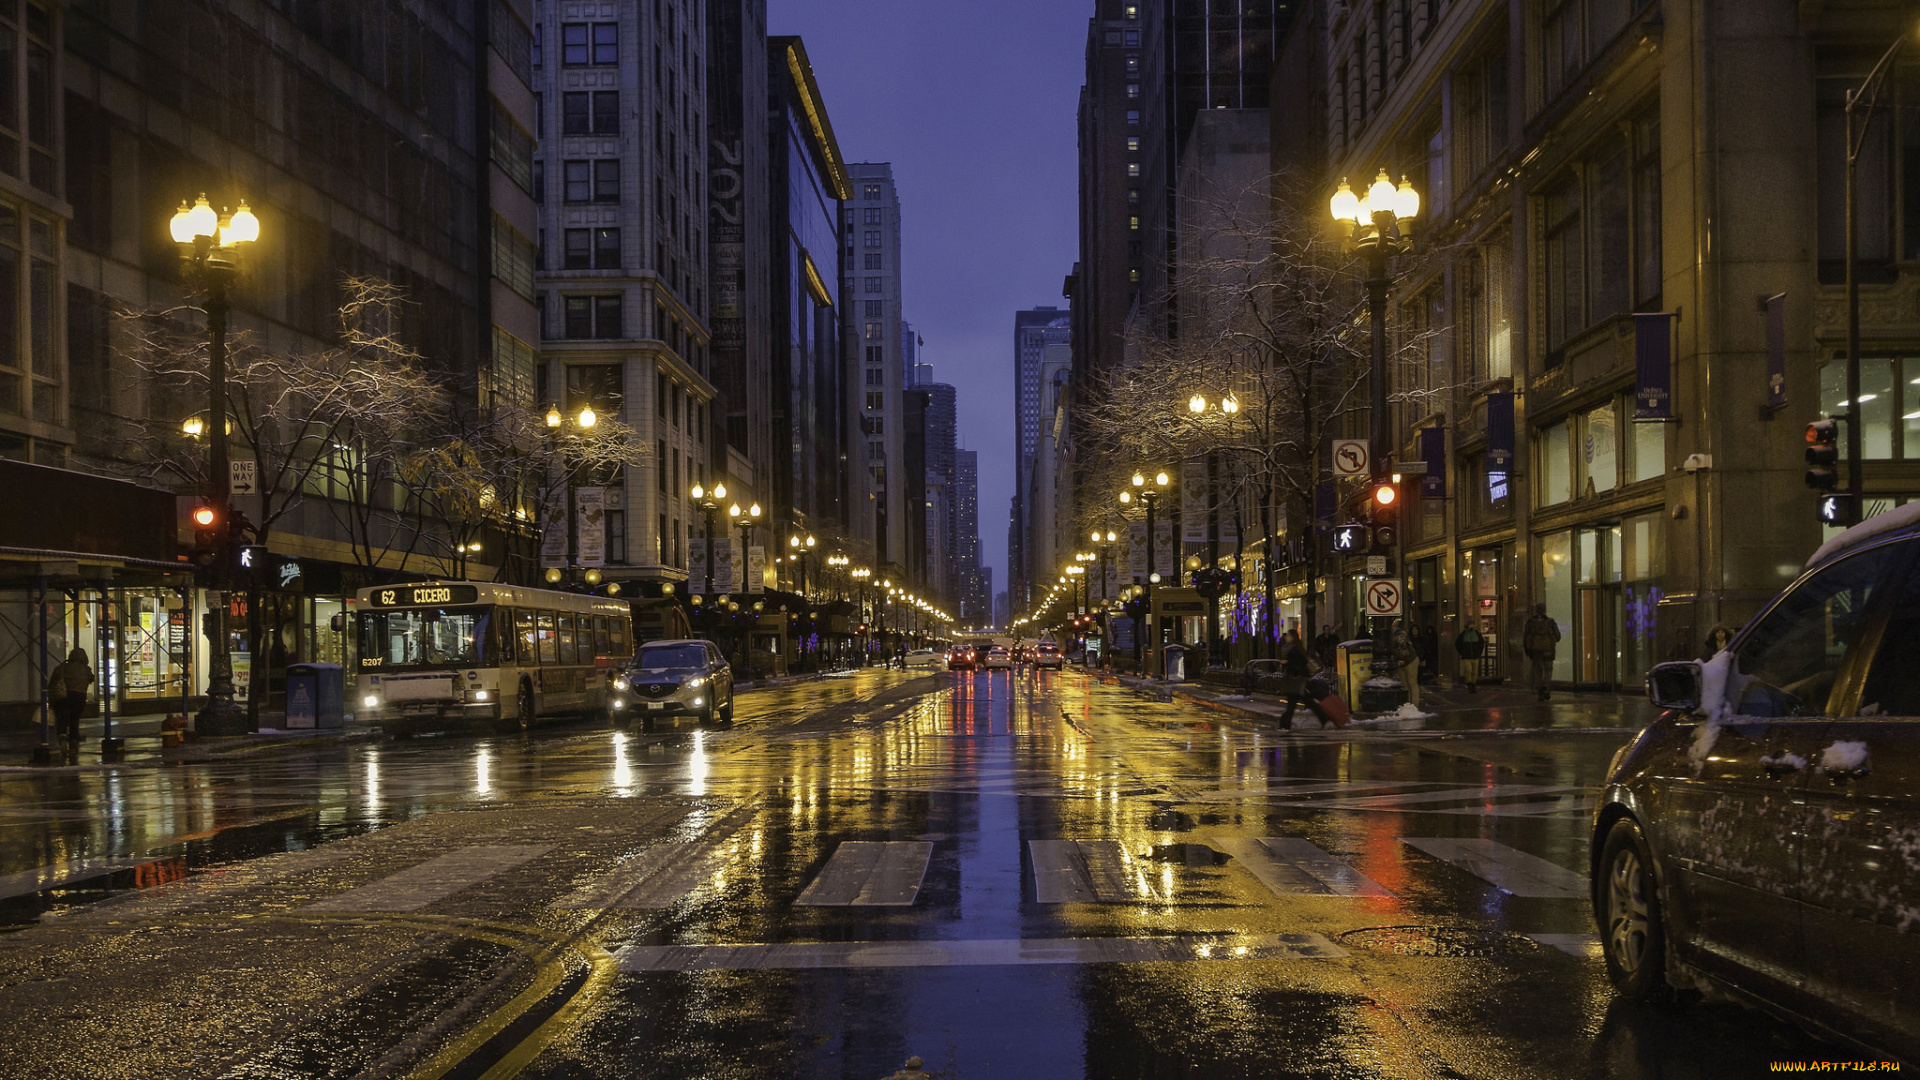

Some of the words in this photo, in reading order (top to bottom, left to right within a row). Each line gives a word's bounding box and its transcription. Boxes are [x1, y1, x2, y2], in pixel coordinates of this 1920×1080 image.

[709, 139, 742, 225] 202
[232, 462, 253, 472] ONE
[232, 472, 253, 481] WAY
[381, 590, 396, 605] 62
[413, 587, 451, 604] CICERO
[361, 657, 383, 667] 6207
